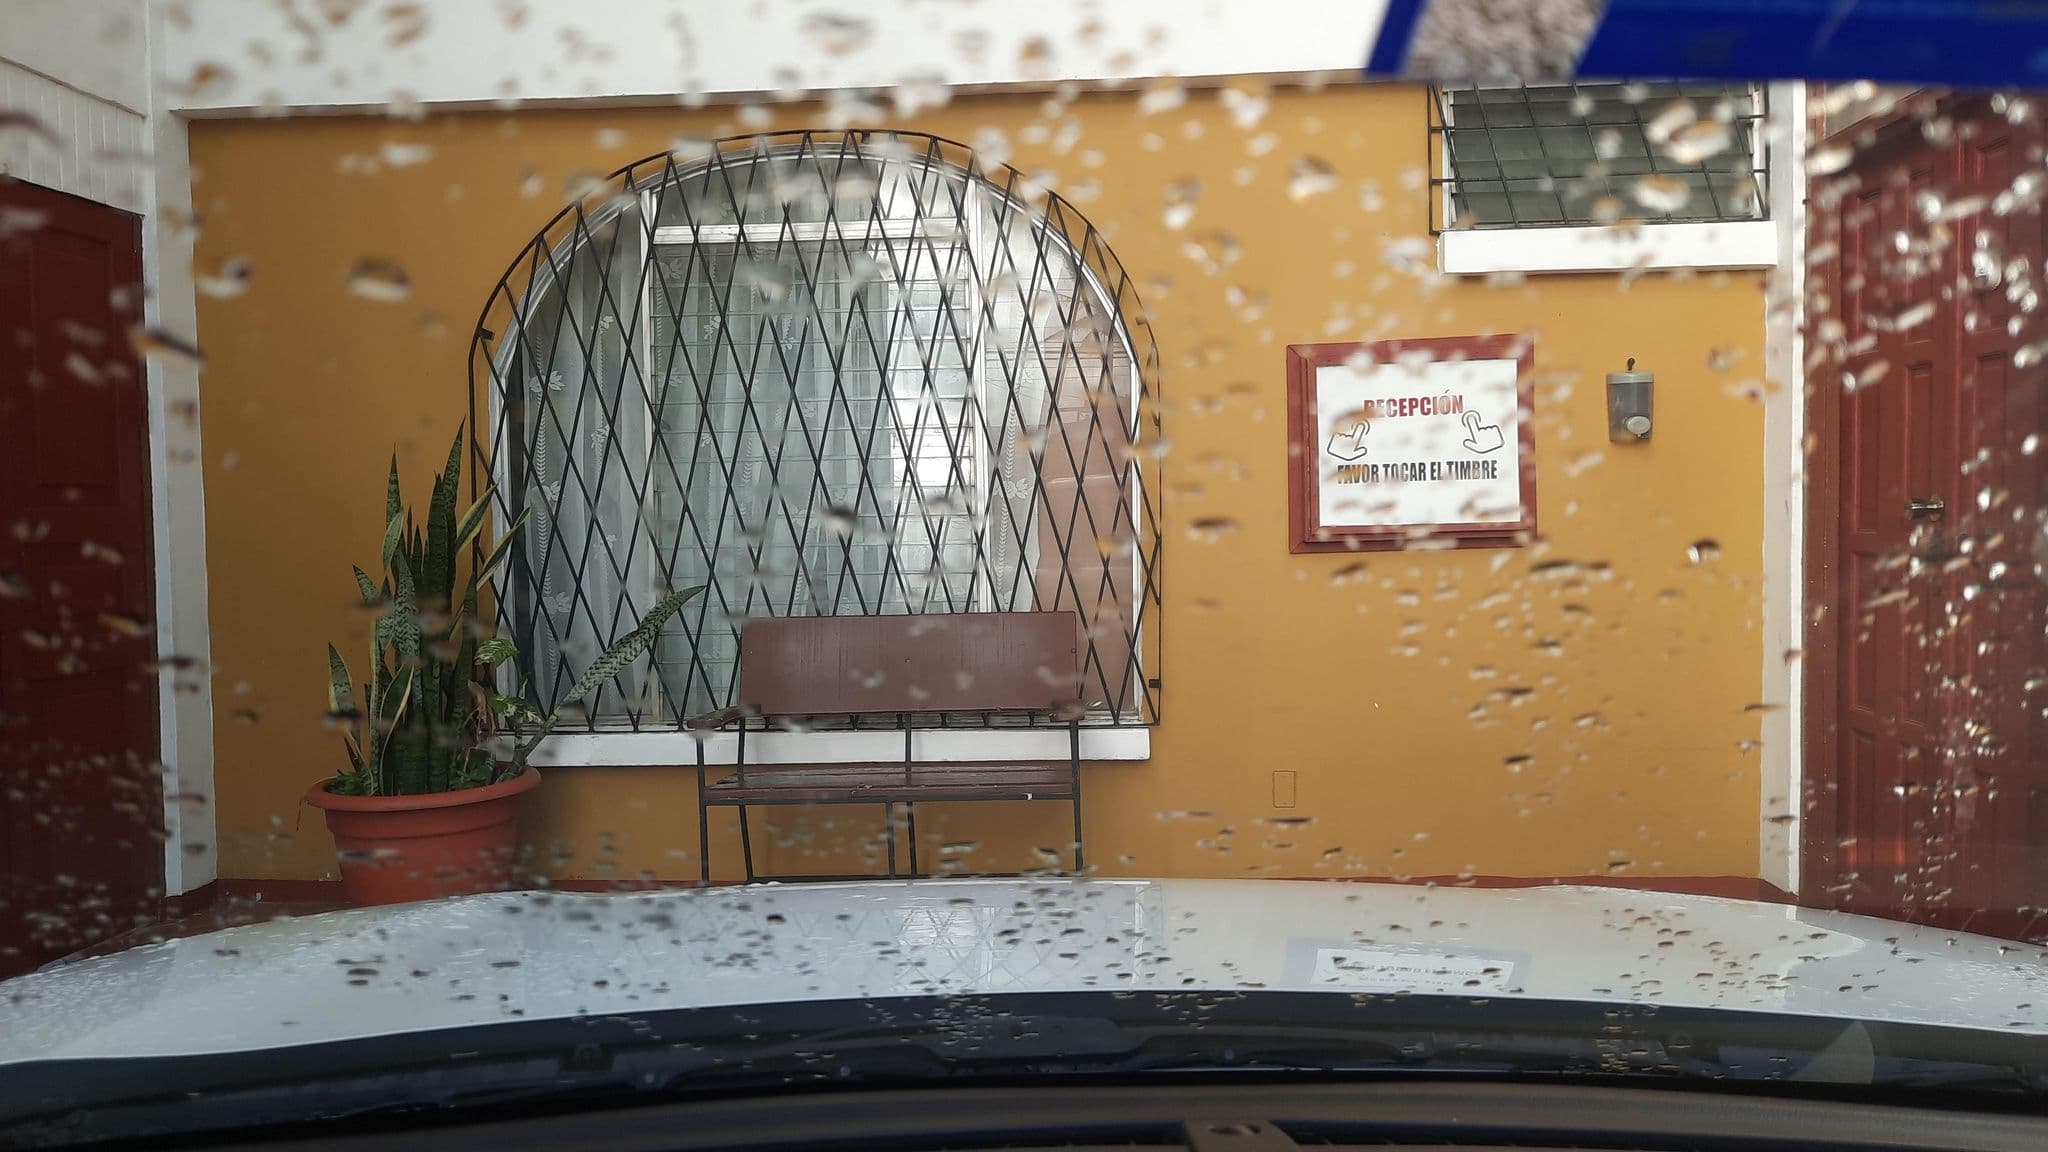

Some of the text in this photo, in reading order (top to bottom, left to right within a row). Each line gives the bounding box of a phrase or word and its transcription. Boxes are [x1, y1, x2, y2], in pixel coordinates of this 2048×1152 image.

[1363, 389, 1465, 418] RECEPCIÓN
[1337, 459, 1498, 485] FAVOR TOCAR EL TIMBRE
